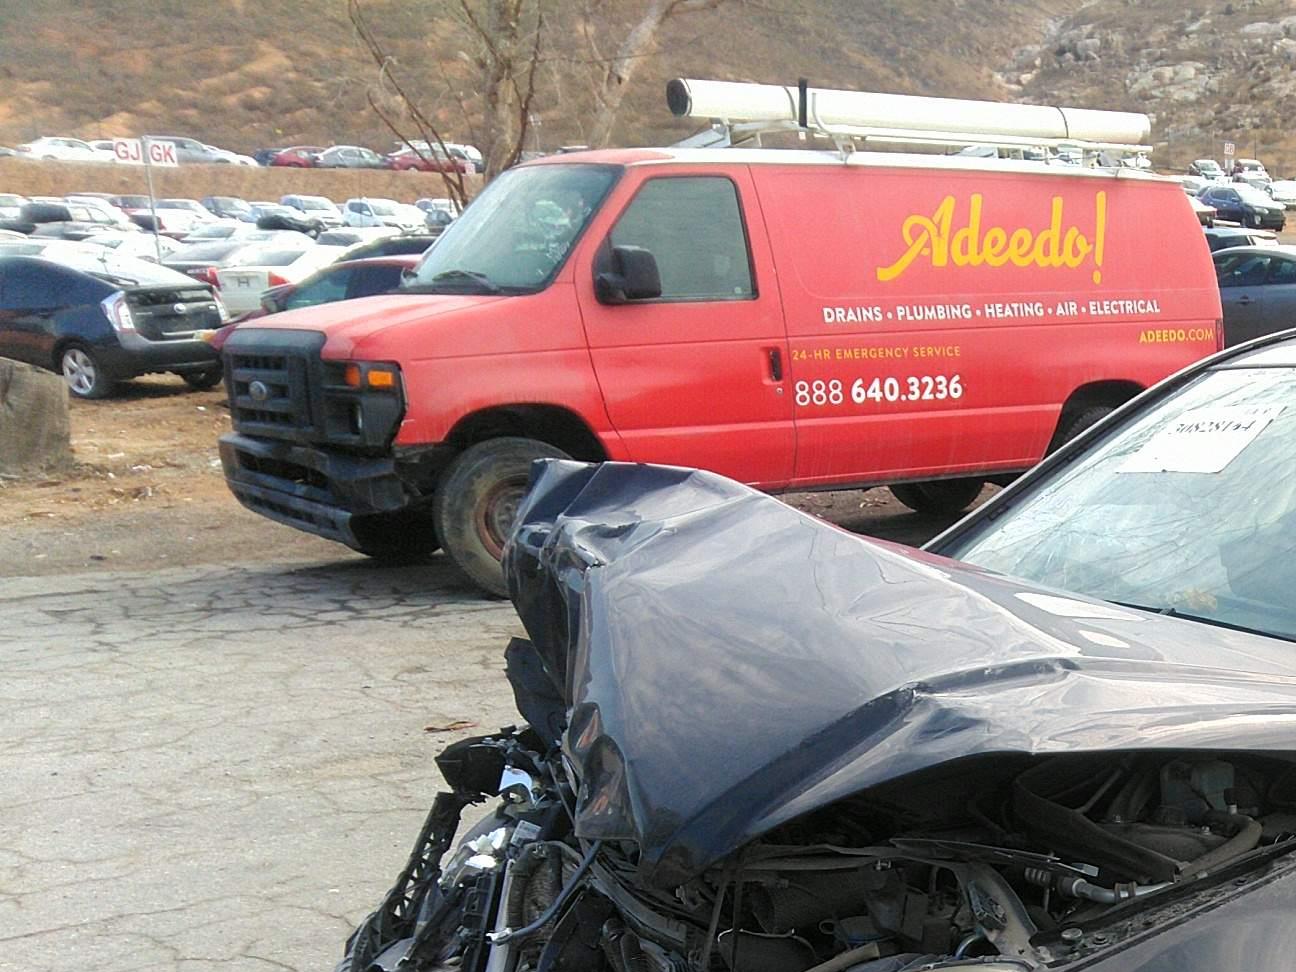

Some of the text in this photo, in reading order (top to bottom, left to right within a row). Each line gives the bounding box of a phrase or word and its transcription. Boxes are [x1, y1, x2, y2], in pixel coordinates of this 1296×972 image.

[115, 142, 140, 160] GJ
[150, 144, 175, 163] GK
[876, 190, 1107, 285] Adeedo!
[822, 299, 1161, 323] DRAINS PLUMBING HEATING AIR ELECTRICAL
[1138, 328, 1214, 344] ADEEDO.COM
[792, 345, 961, 361] 24-HR EMERGENCY SERVICE
[794, 374, 963, 406] 888 640.3236
